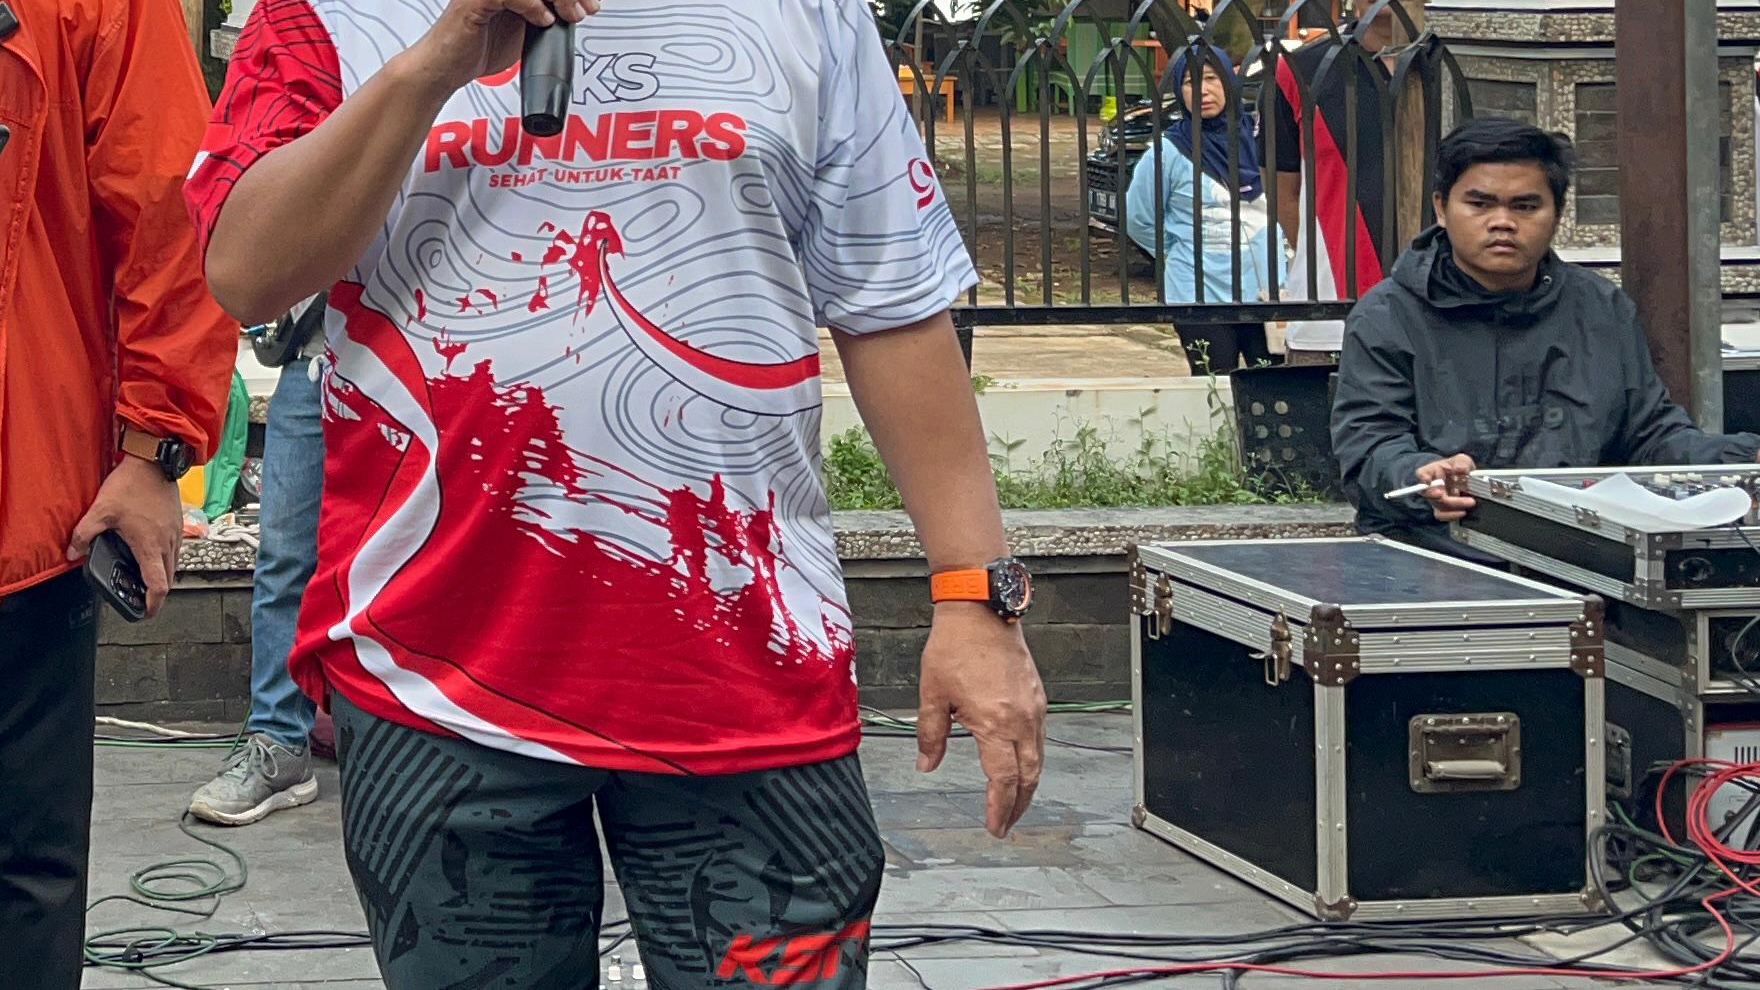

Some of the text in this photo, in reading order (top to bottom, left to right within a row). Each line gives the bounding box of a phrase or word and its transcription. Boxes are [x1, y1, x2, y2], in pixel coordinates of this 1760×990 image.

[424, 109, 749, 173] RUNNERS
[489, 166, 682, 188] SEHAT UNTUK TAAT
